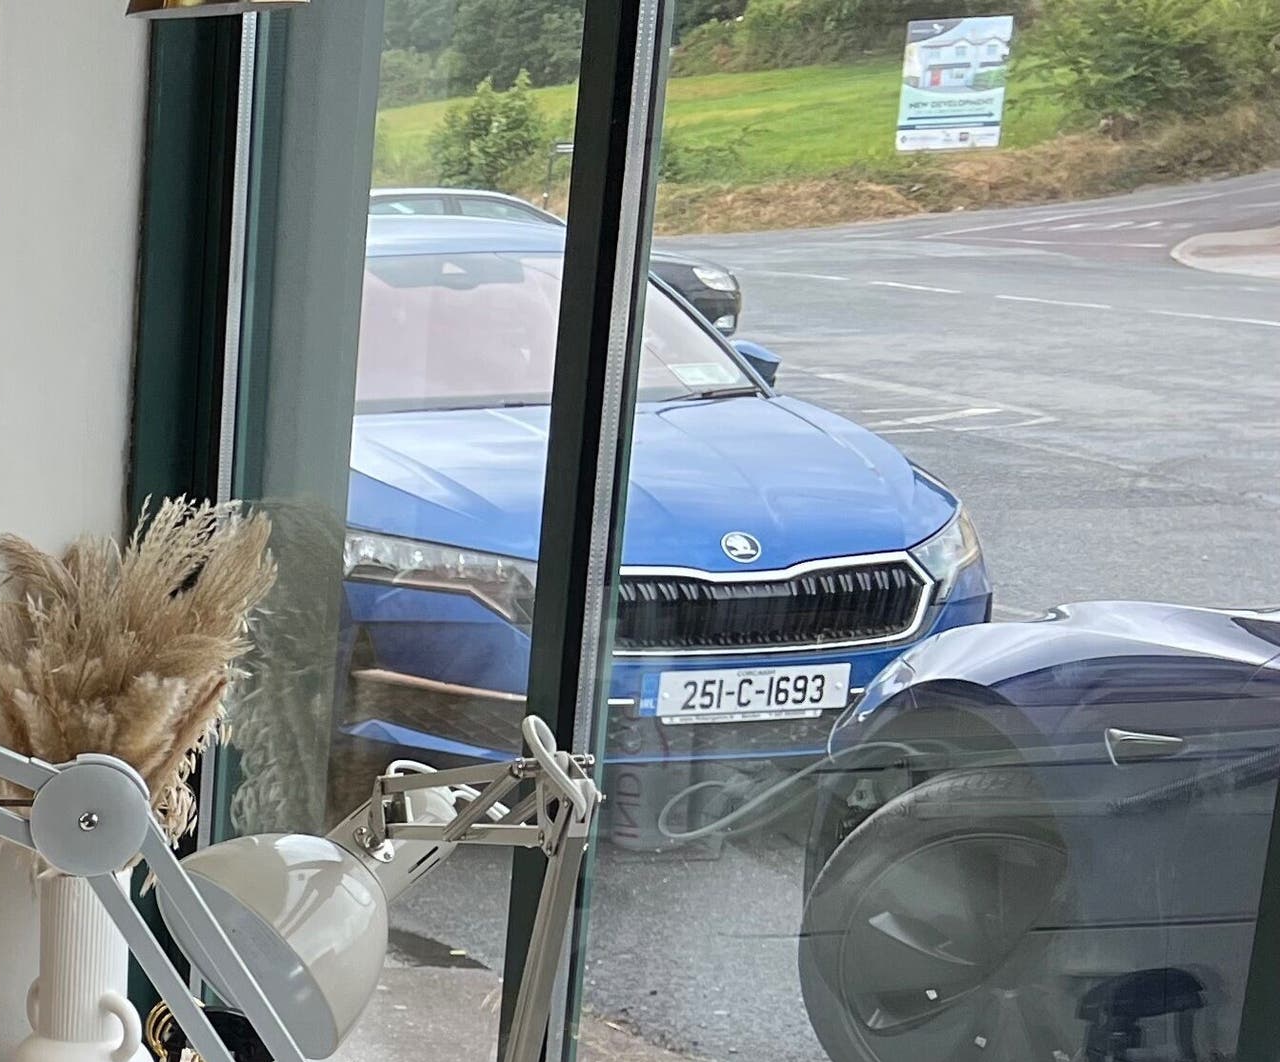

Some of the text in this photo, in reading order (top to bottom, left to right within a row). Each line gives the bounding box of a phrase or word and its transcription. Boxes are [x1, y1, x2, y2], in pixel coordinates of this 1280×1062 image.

[909, 98, 994, 109] NEW DEVELOPMENT
[681, 674, 826, 711] 251-C-1693
